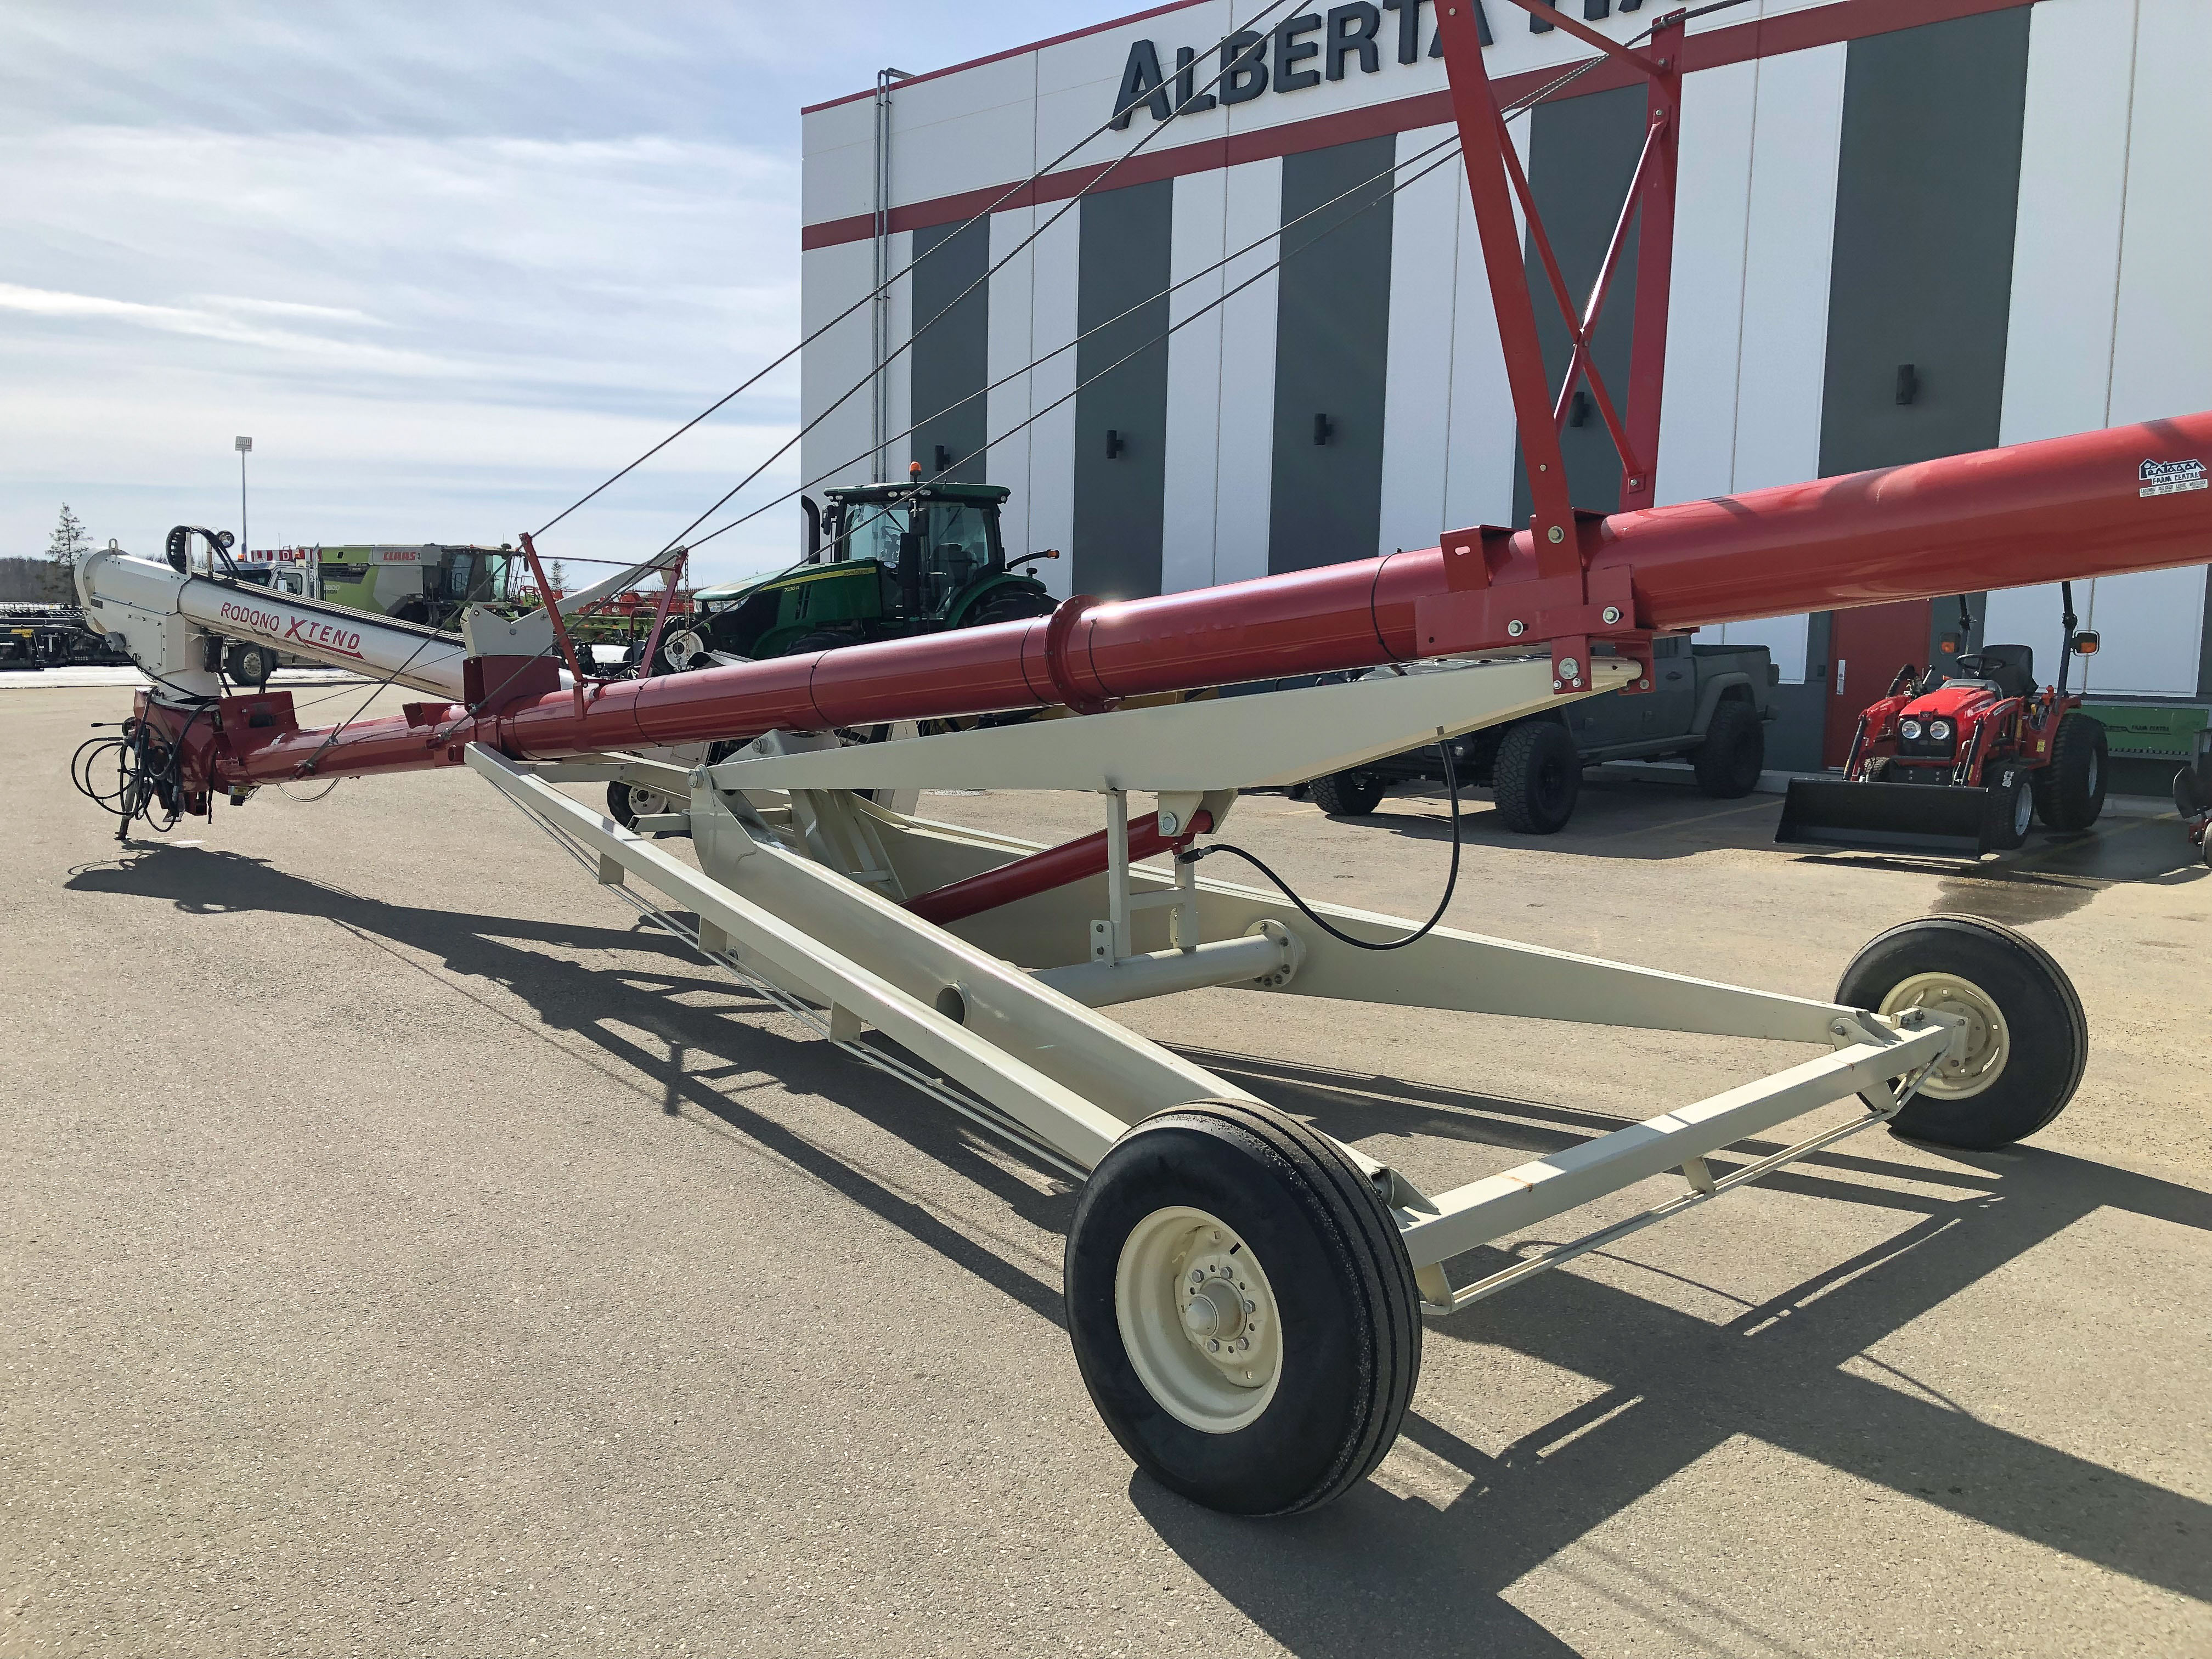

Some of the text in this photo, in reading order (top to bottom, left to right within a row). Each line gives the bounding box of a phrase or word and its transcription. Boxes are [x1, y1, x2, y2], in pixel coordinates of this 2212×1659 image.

[2174, 472, 2199, 481] CENTRE
[283, 551, 290, 560] D
[383, 552, 416, 561] CLAAS
[221, 602, 360, 650] RODONO XTEND
